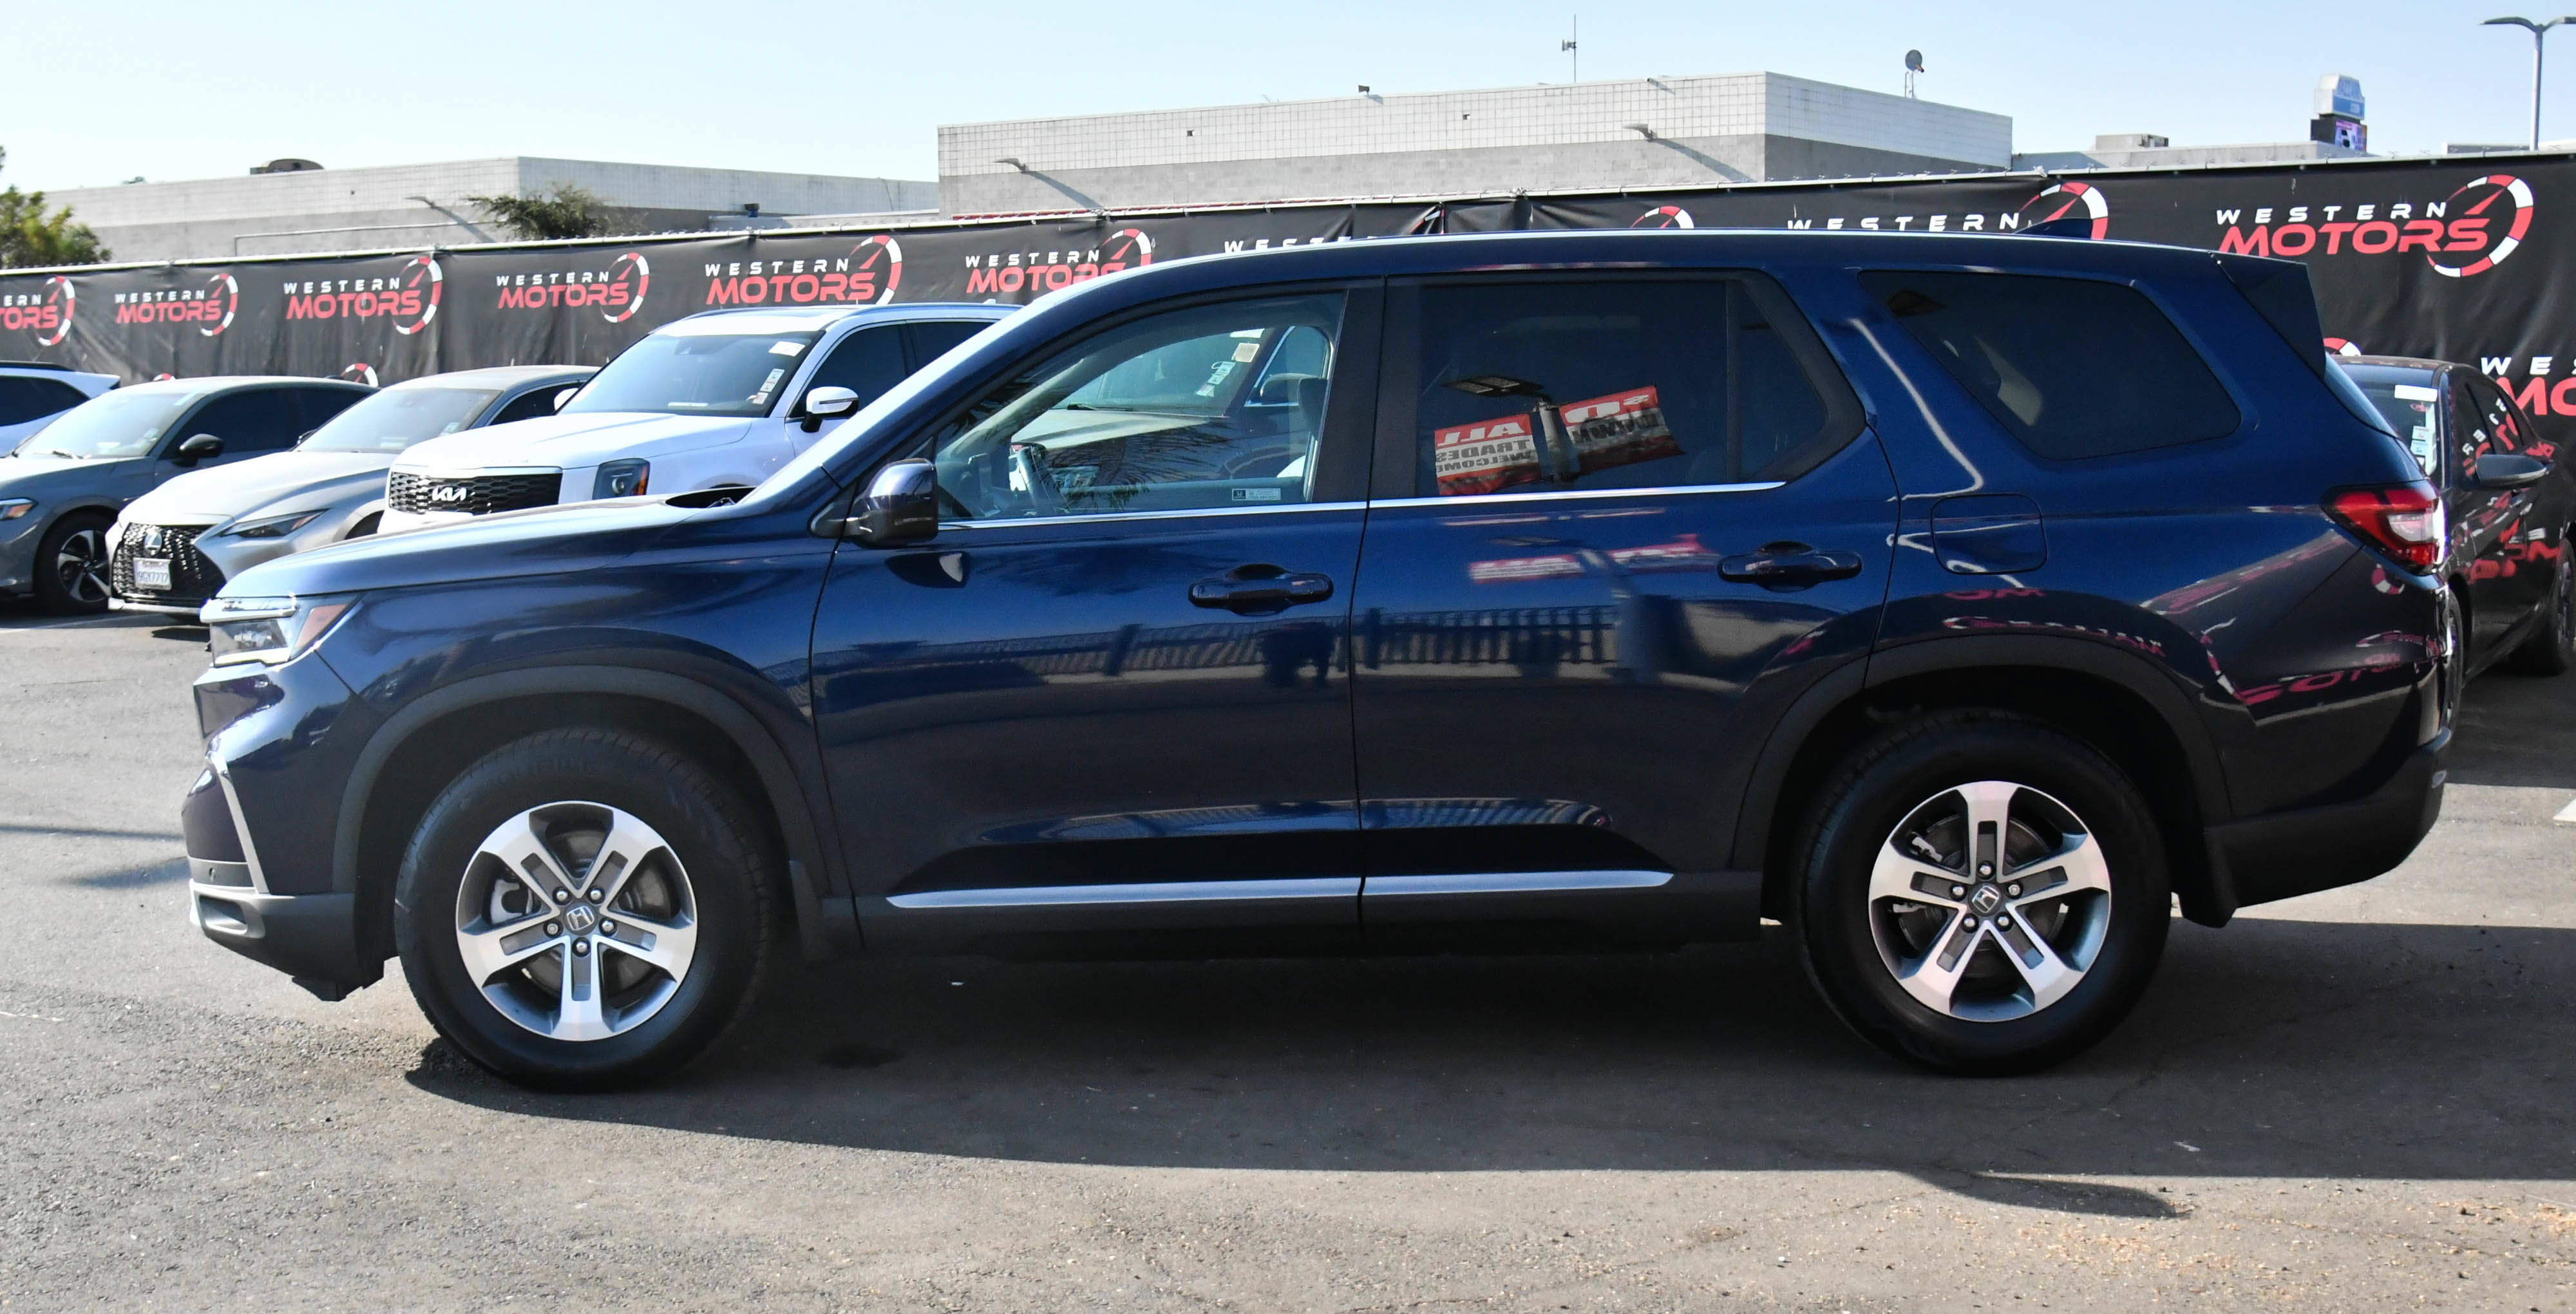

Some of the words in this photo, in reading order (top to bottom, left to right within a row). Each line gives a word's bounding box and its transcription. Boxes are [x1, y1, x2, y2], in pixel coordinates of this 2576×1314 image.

[1787, 212, 2020, 232] WESTERN
[2217, 202, 2447, 225] WESTERN
[2218, 218, 2490, 257] MOTORS
[705, 258, 849, 275] WESTERN
[965, 249, 1100, 268] WESTERN
[283, 277, 400, 294] WESTERN
[496, 271, 609, 287] WESTERN
[706, 272, 875, 305] MOTORS
[115, 290, 205, 304] WESTERN
[286, 290, 421, 319] MOTORS
[498, 281, 629, 309] MOTORS
[117, 299, 222, 324] MOTORS
